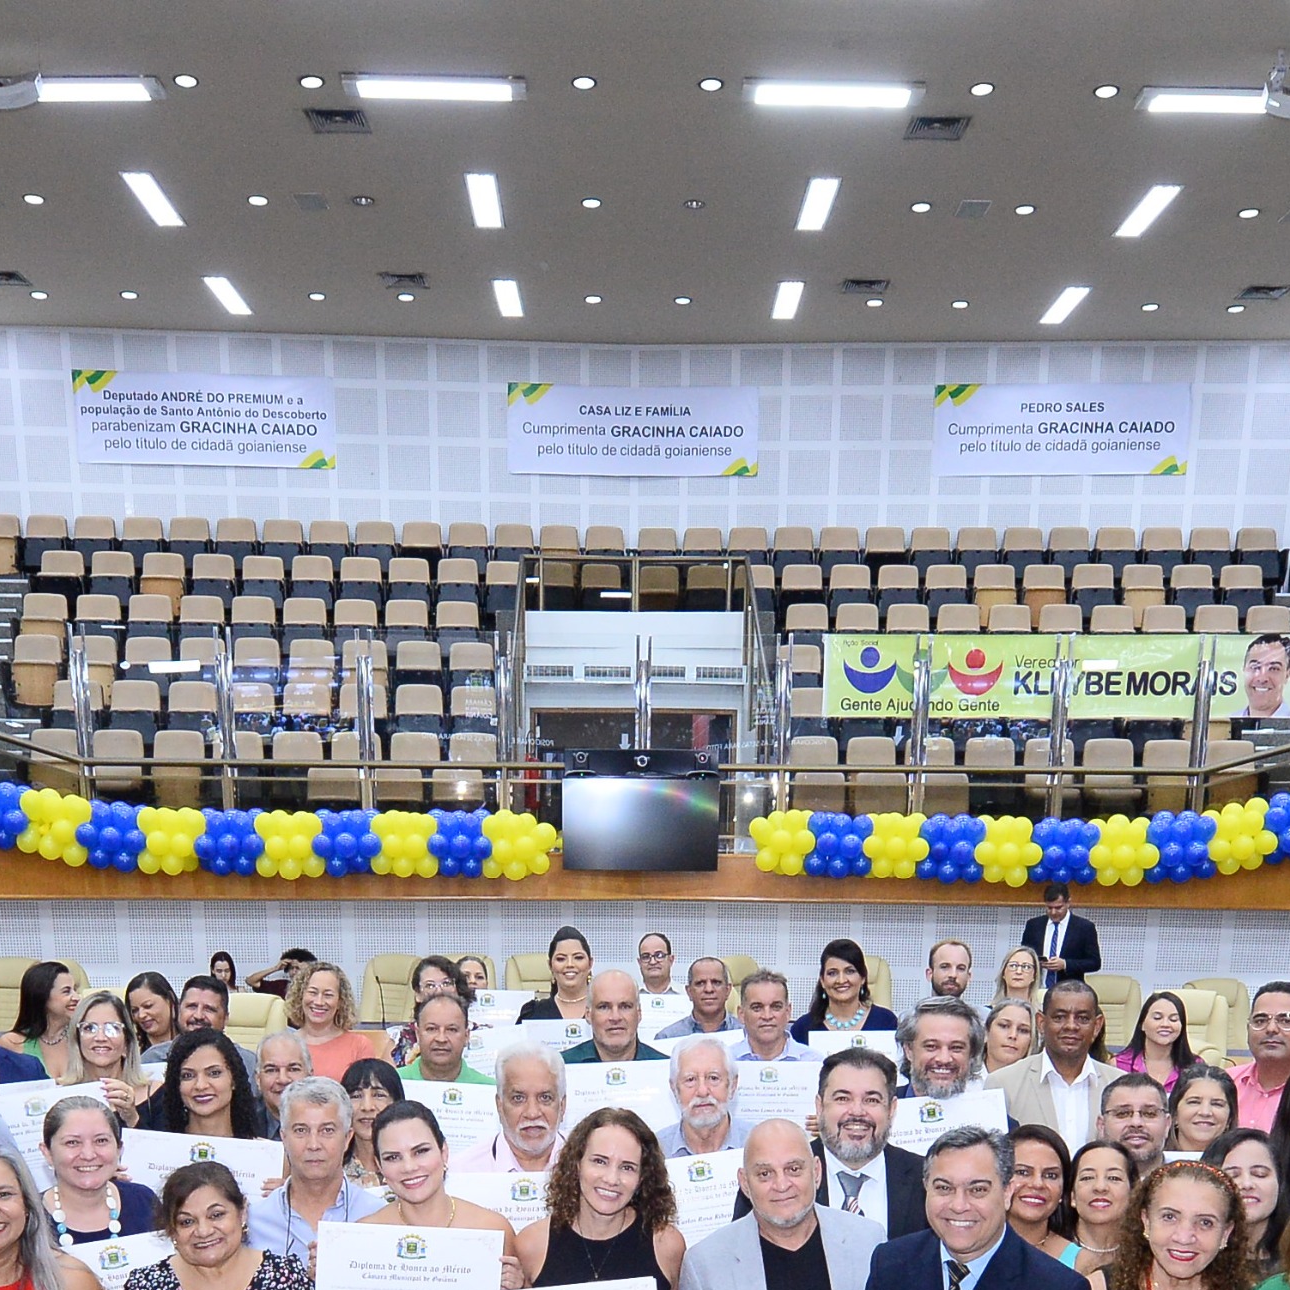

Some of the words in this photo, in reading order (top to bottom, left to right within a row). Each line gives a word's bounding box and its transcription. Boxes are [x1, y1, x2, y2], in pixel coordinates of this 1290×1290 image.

[103, 390, 158, 403] Deputado
[161, 389, 202, 402] ANDRÉ
[207, 393, 225, 403] DO
[228, 393, 283, 405] PREMIUM
[297, 397, 303, 405] a
[81, 406, 140, 417] população
[144, 406, 157, 416] de
[161, 405, 193, 416] Santo
[197, 407, 241, 417] Antônio
[245, 408, 258, 418] do
[263, 409, 327, 420] Descoberto
[579, 405, 611, 416] CASA
[615, 406, 631, 416] LIZ
[635, 407, 642, 416] E
[646, 404, 691, 416] FAMÍLIA
[1021, 403, 1062, 412] PEDRO
[1066, 402, 1104, 412] SALES
[92, 419, 176, 433] parabenizam
[180, 421, 257, 435] GRACINHA
[261, 424, 317, 436] CAIADO
[522, 422, 605, 437] Cumprimenta
[611, 425, 685, 438] GRACINHA
[689, 426, 743, 438] CAIADO
[948, 423, 1033, 438] Cumprimenta
[1038, 422, 1114, 434] GRACINHA
[1118, 421, 1175, 433] CAIADO
[960, 441, 986, 454] pelo
[990, 440, 1021, 452] título
[1025, 440, 1041, 451] de
[1045, 439, 1087, 451] cidadã
[1091, 439, 1161, 453] goianiense
[840, 698, 882, 712] Gente
[958, 699, 1000, 712] Gente
